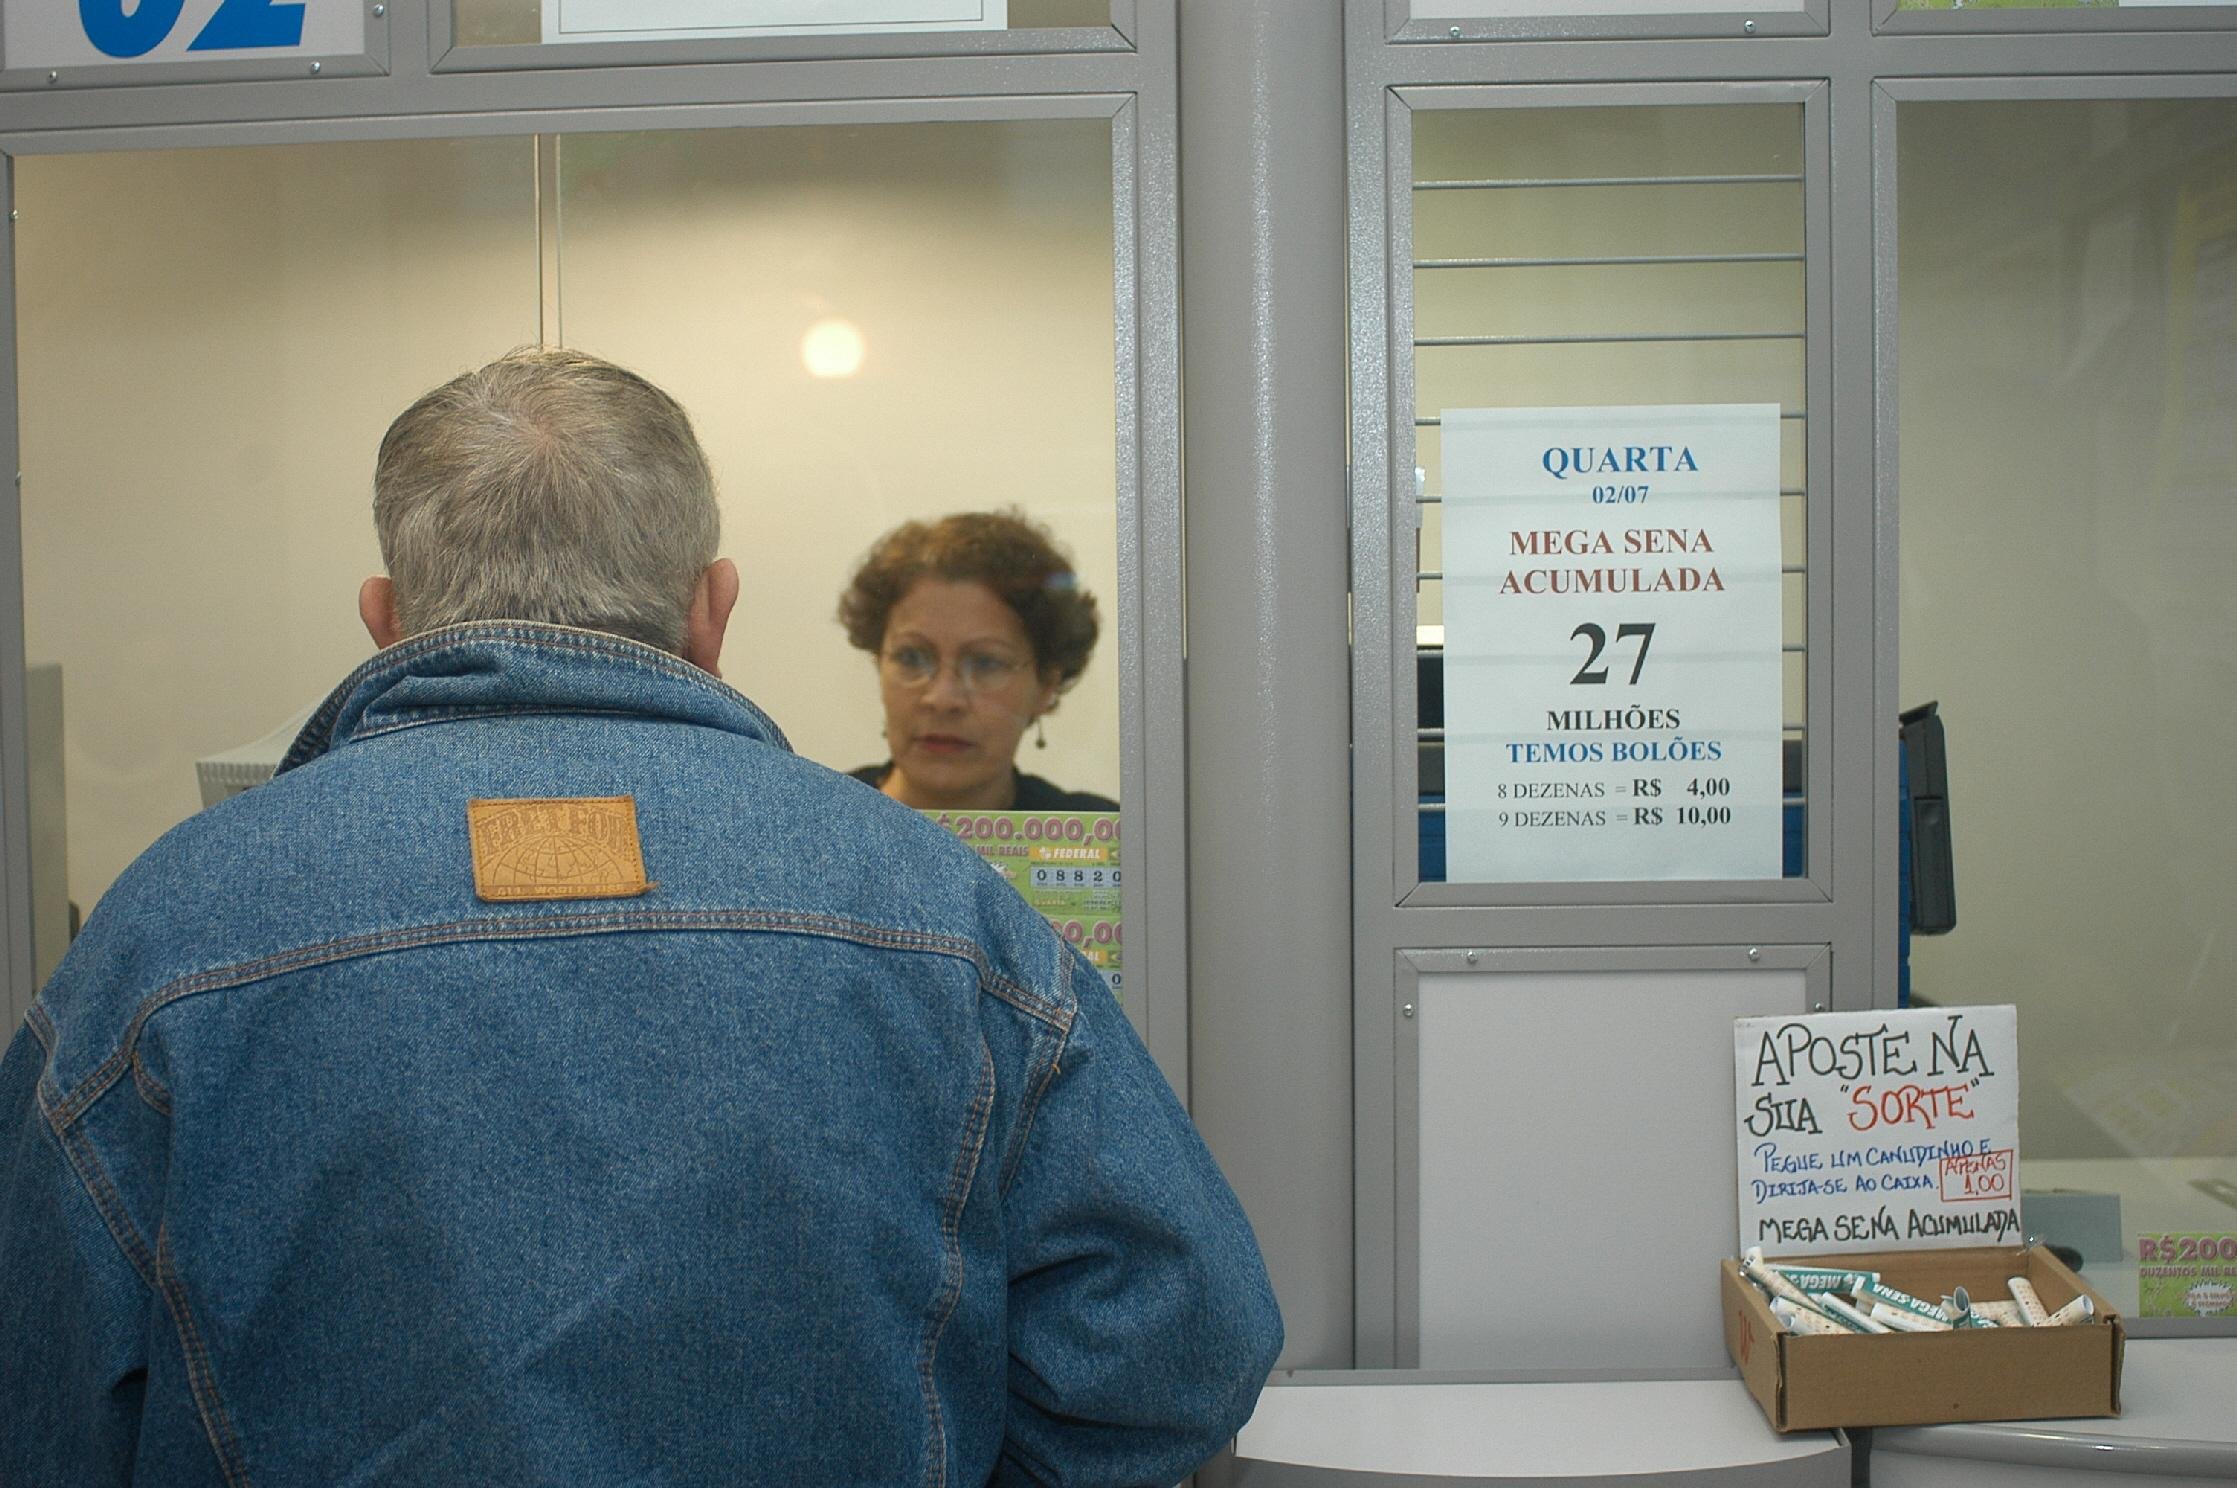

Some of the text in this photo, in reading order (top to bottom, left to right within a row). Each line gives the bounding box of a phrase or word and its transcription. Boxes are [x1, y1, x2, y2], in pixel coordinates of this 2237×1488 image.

[1542, 446, 1699, 479] QUARTA
[1592, 485, 1649, 505] 02/07
[1509, 528, 1714, 556] MEGA SENA
[1500, 567, 1725, 595] ACUMULADA
[1569, 622, 1656, 685] 27
[1546, 705, 1681, 731] MILHÕES
[1506, 737, 1722, 763] TEMOS BOLÕES
[1498, 782, 1508, 799] 8
[1513, 781, 1605, 799] DEZENAS
[1632, 778, 1662, 798] R$
[1687, 778, 1730, 799] 4,00
[1499, 811, 1509, 828] 9
[1515, 810, 1607, 828] DEZENAS
[1634, 806, 1664, 827] R$
[1677, 806, 1731, 828] 10,00
[1053, 848, 1101, 859] FEDERAL
[1752, 1015, 1994, 1086] APOSTE NA
[1744, 1092, 1823, 1138] SUA
[1754, 1142, 1823, 1174] PEGUE
[1831, 1150, 1862, 1169] UM
[1751, 1177, 1848, 1205] DIRIJA-SE
[1855, 1176, 1877, 1193] AO
[1759, 1205, 2021, 1244] MEGA SENA ACUMULADA
[1800, 1273, 1841, 1290] MEGA
[1872, 1282, 1911, 1304] SENA
